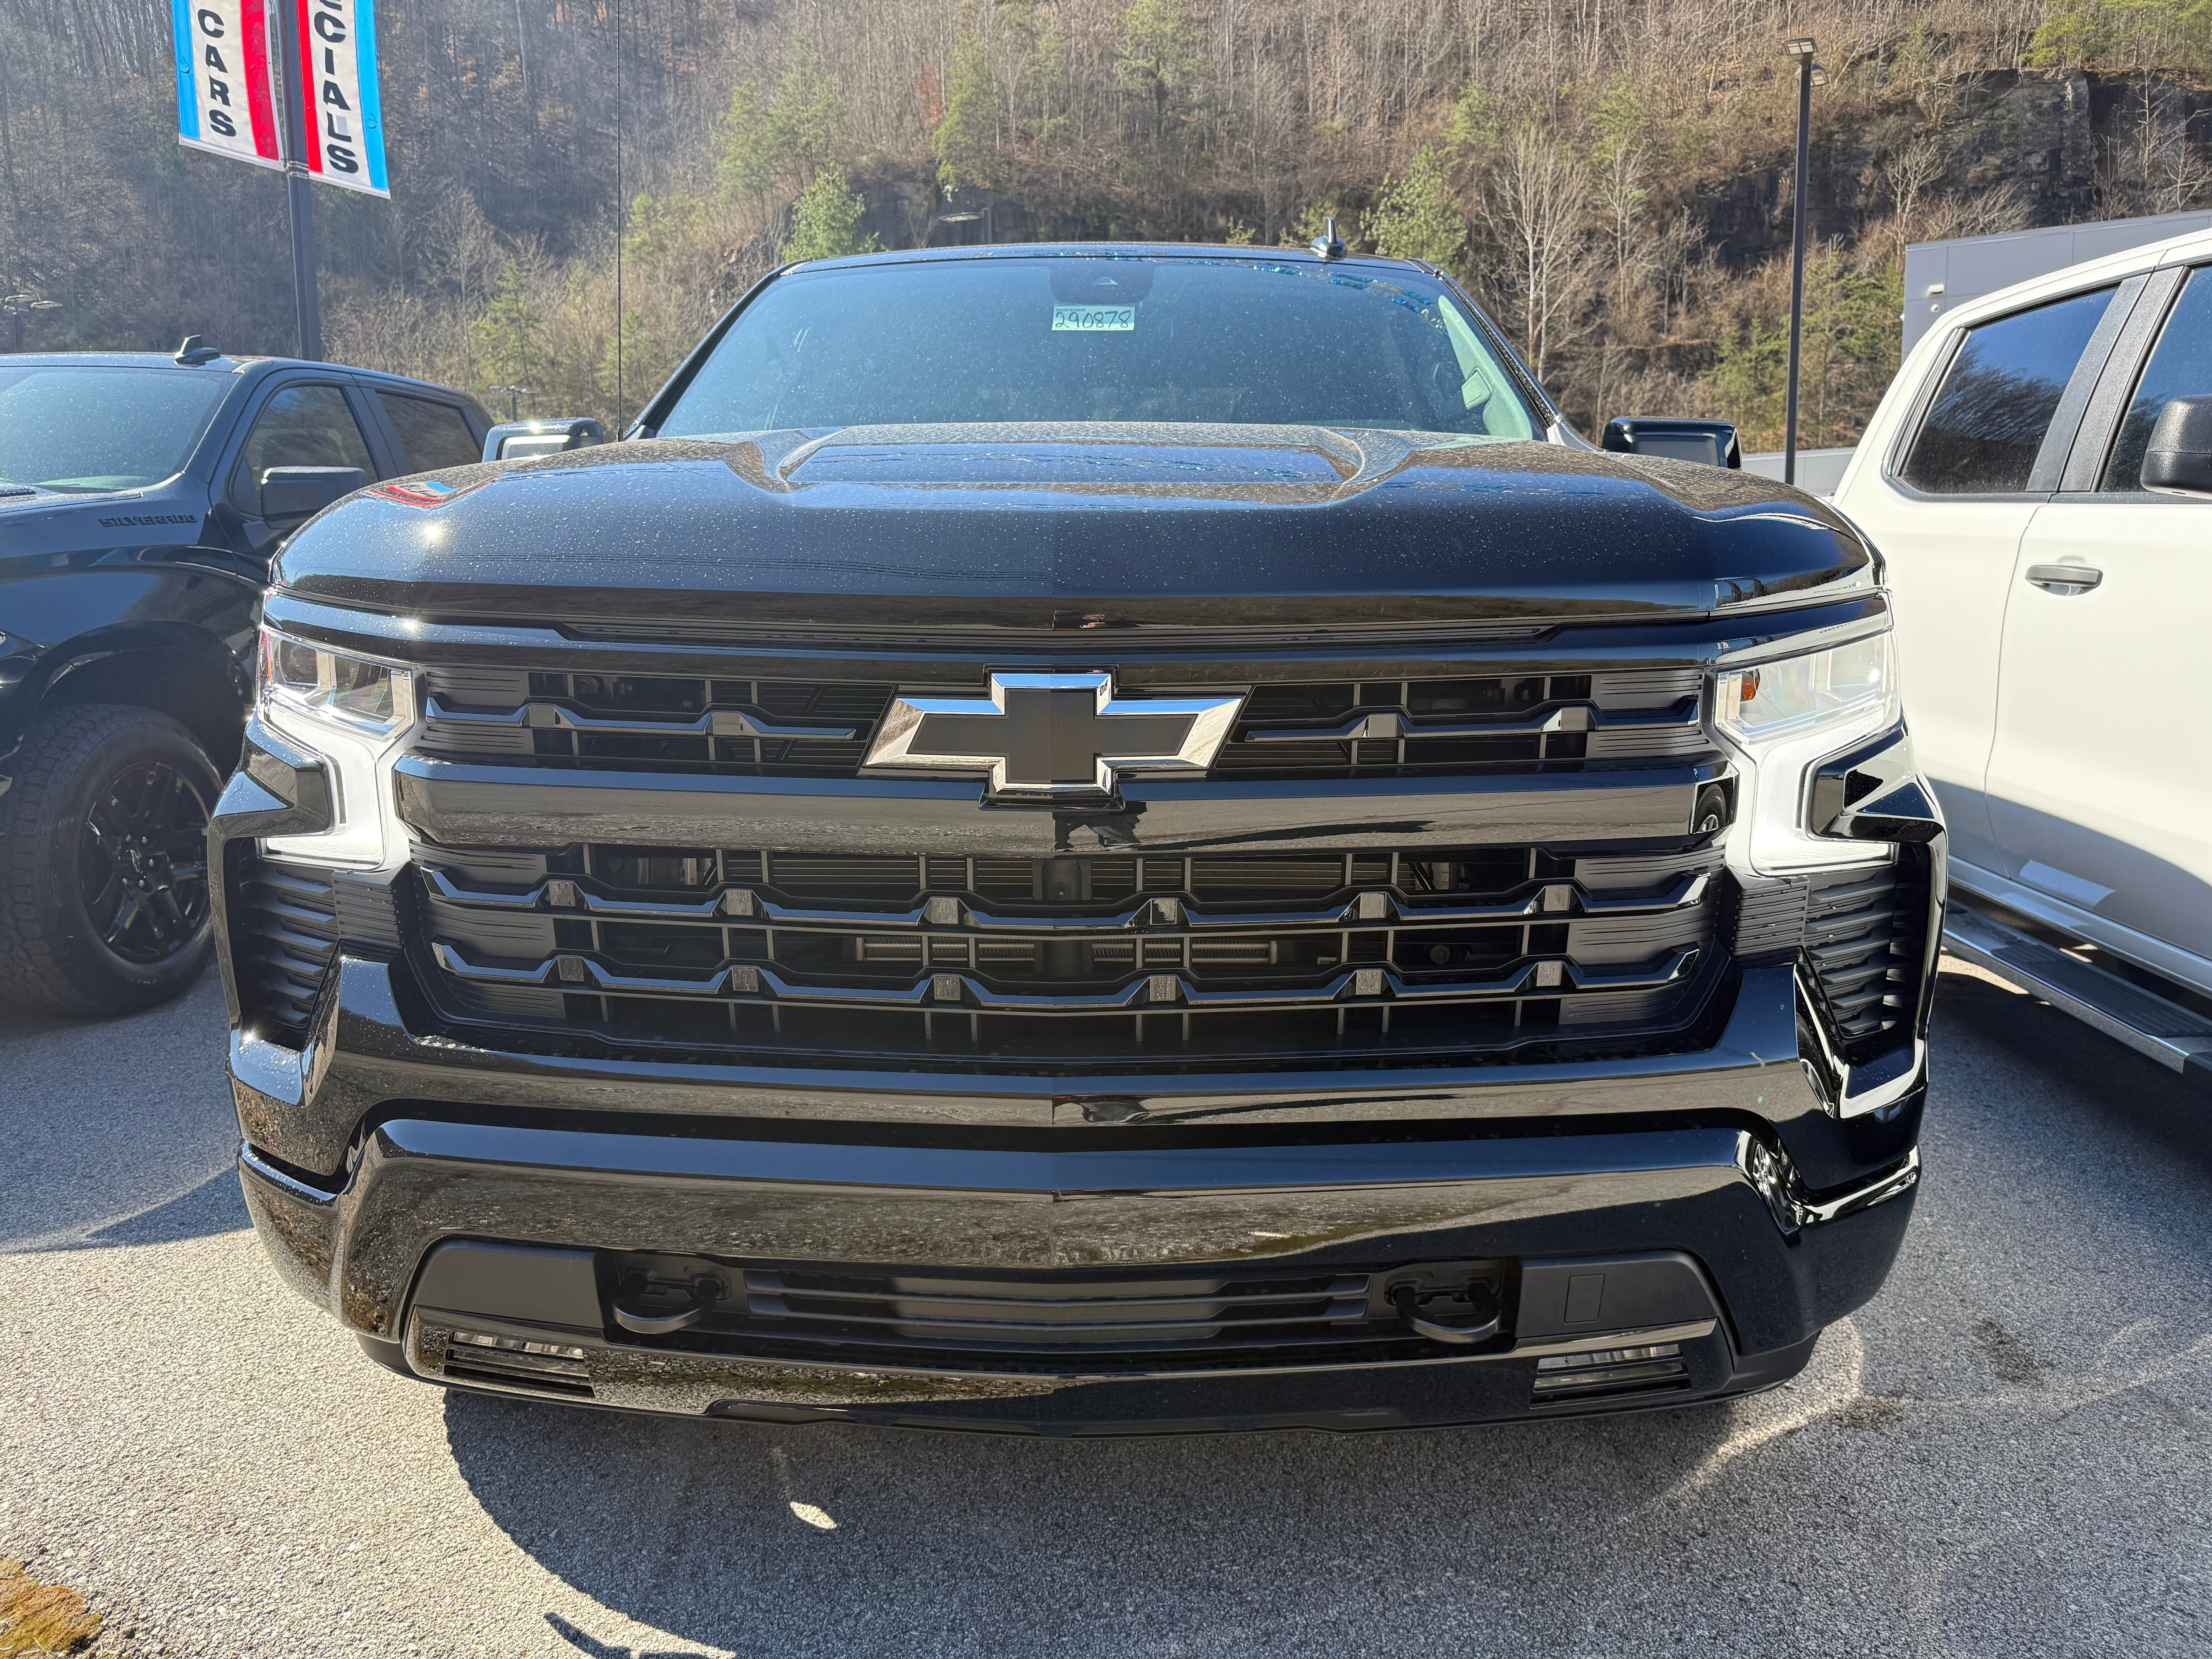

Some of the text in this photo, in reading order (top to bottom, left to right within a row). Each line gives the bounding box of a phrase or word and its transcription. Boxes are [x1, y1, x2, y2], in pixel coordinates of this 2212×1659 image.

[198, 9, 236, 137] CARS
[1055, 310, 1131, 328] 290878
[98, 514, 198, 527] SILVERADO
